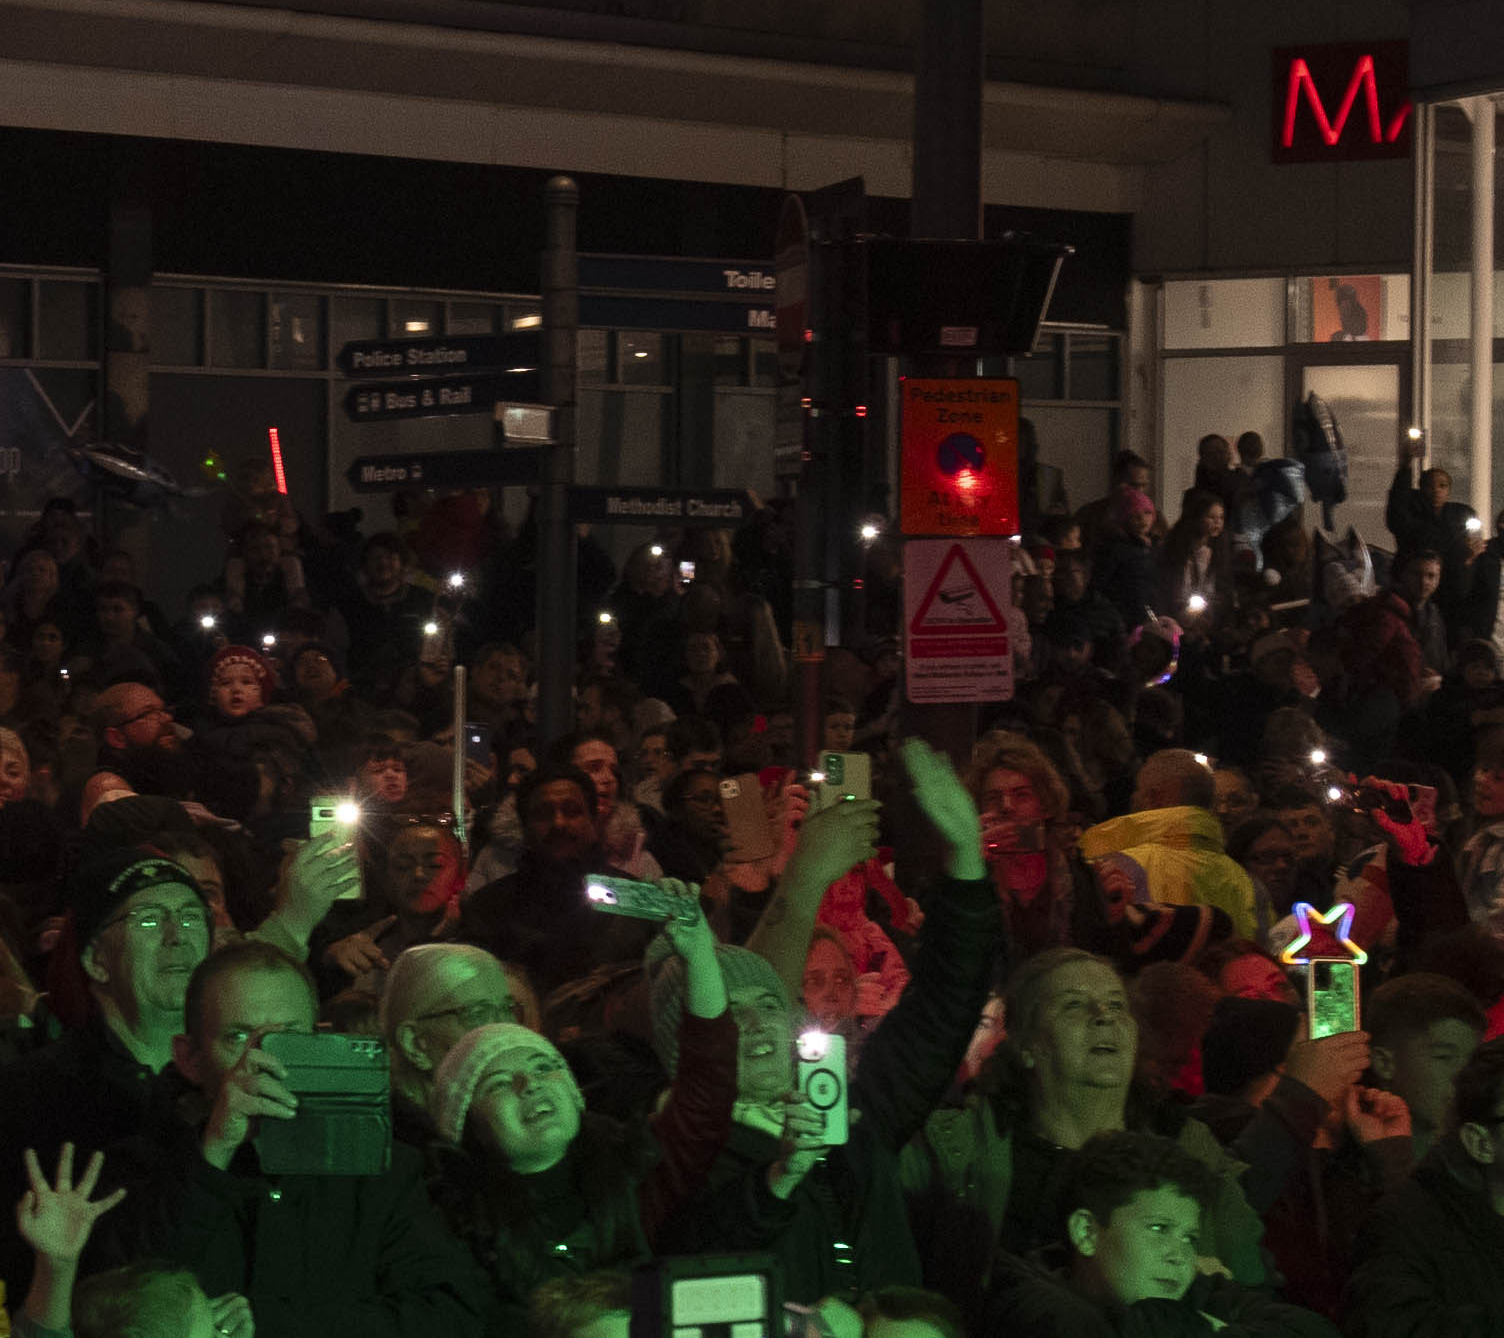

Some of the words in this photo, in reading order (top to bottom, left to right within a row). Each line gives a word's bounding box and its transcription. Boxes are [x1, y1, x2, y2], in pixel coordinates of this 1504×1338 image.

[724, 269, 775, 290] Toile
[353, 348, 402, 368] Police
[407, 347, 469, 366] Station
[386, 392, 416, 409] Bus
[440, 386, 472, 405] Rail
[911, 387, 1012, 404] Pedestrian
[936, 407, 985, 424] Zone
[361, 465, 407, 483] Metro
[607, 497, 682, 517] Methodist
[687, 500, 743, 519] Church
